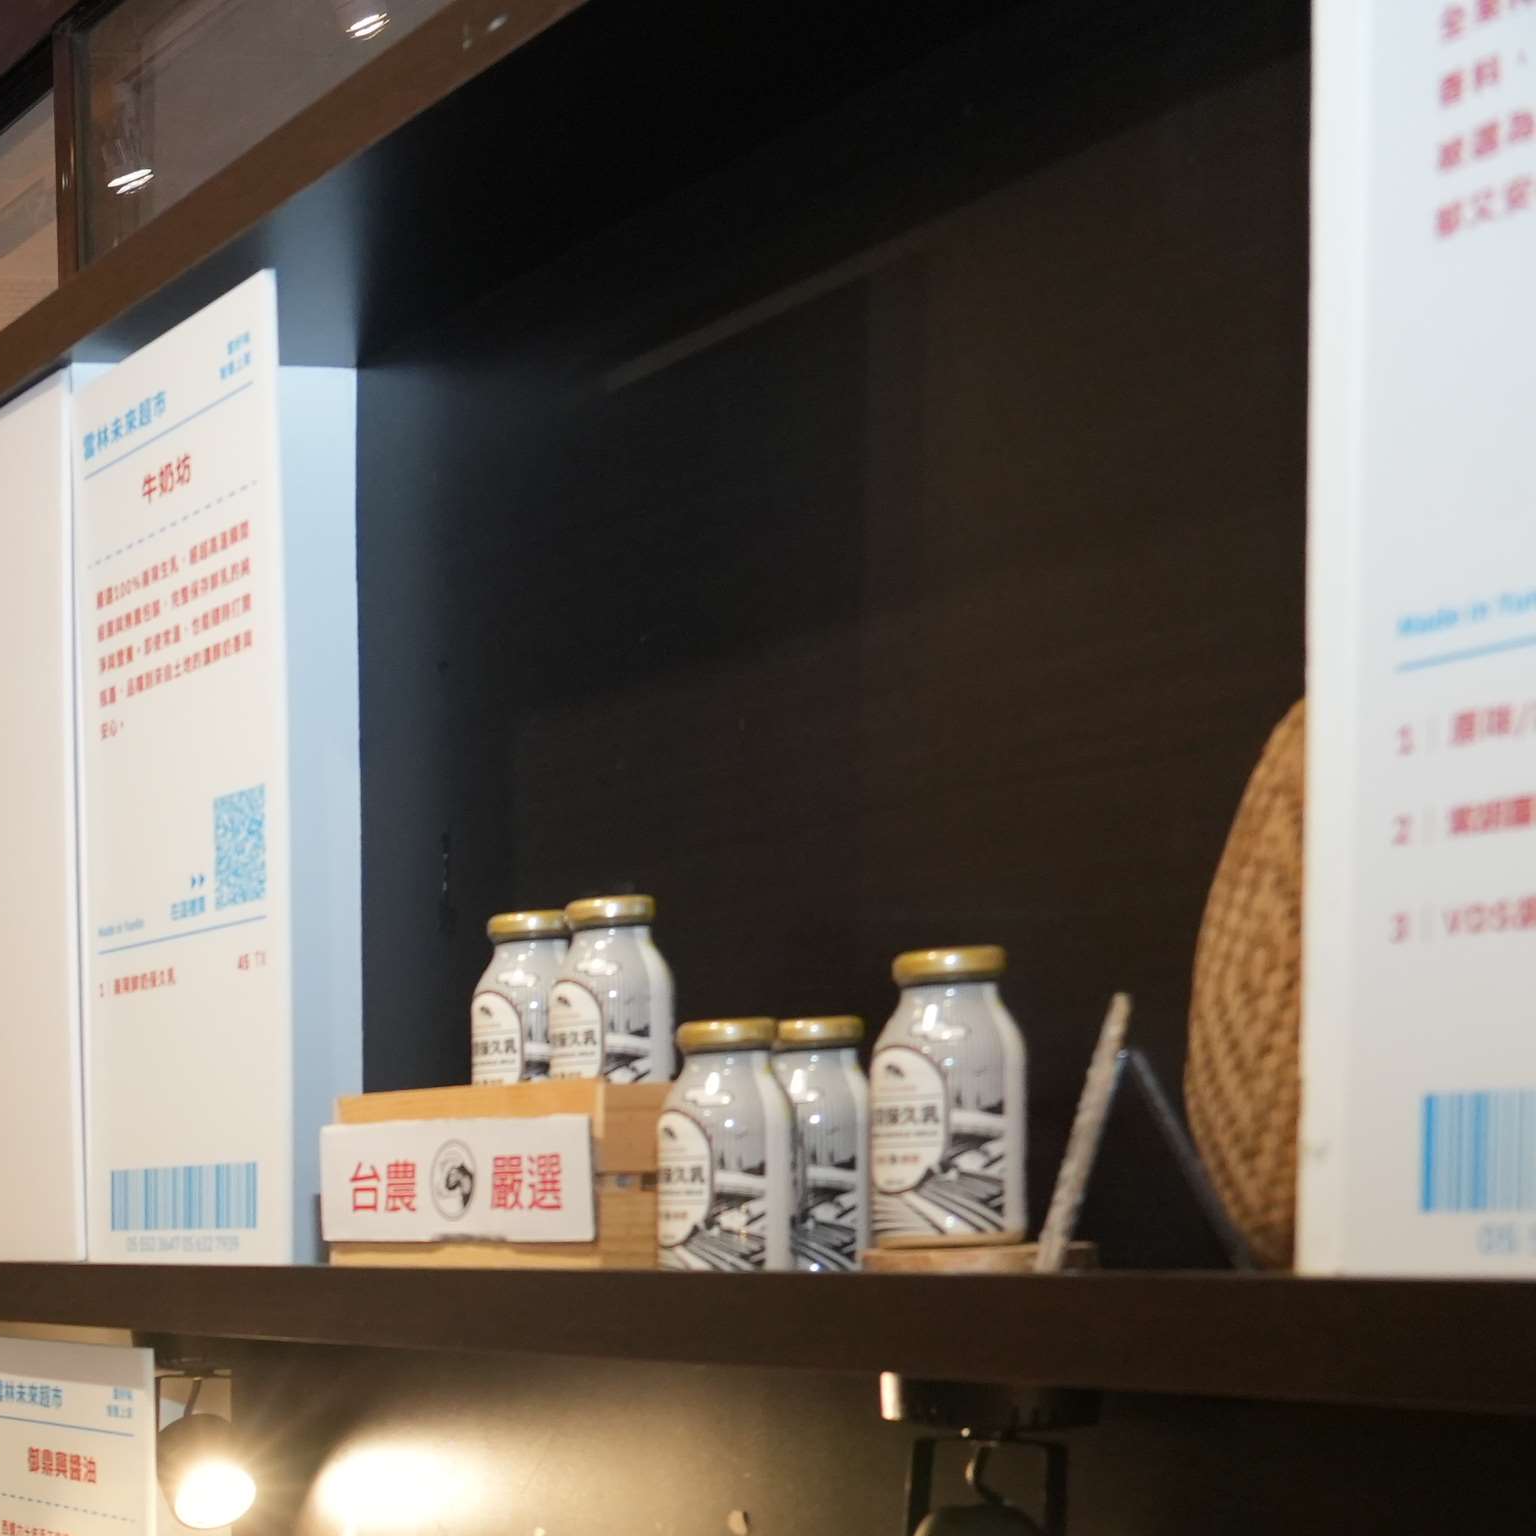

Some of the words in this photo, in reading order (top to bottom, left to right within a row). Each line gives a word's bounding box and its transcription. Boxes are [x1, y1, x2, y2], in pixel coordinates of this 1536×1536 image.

[83, 390, 166, 461] 雲林未來超市
[142, 453, 191, 503] 牛奶坊
[1398, 724, 1413, 755] 1
[1393, 813, 1410, 846] 2
[1391, 910, 1409, 944] 3
[350, 1159, 417, 1213] 台農
[491, 1153, 563, 1211] 嚴選
[28, 1446, 96, 1485] 御鼎興醬油
